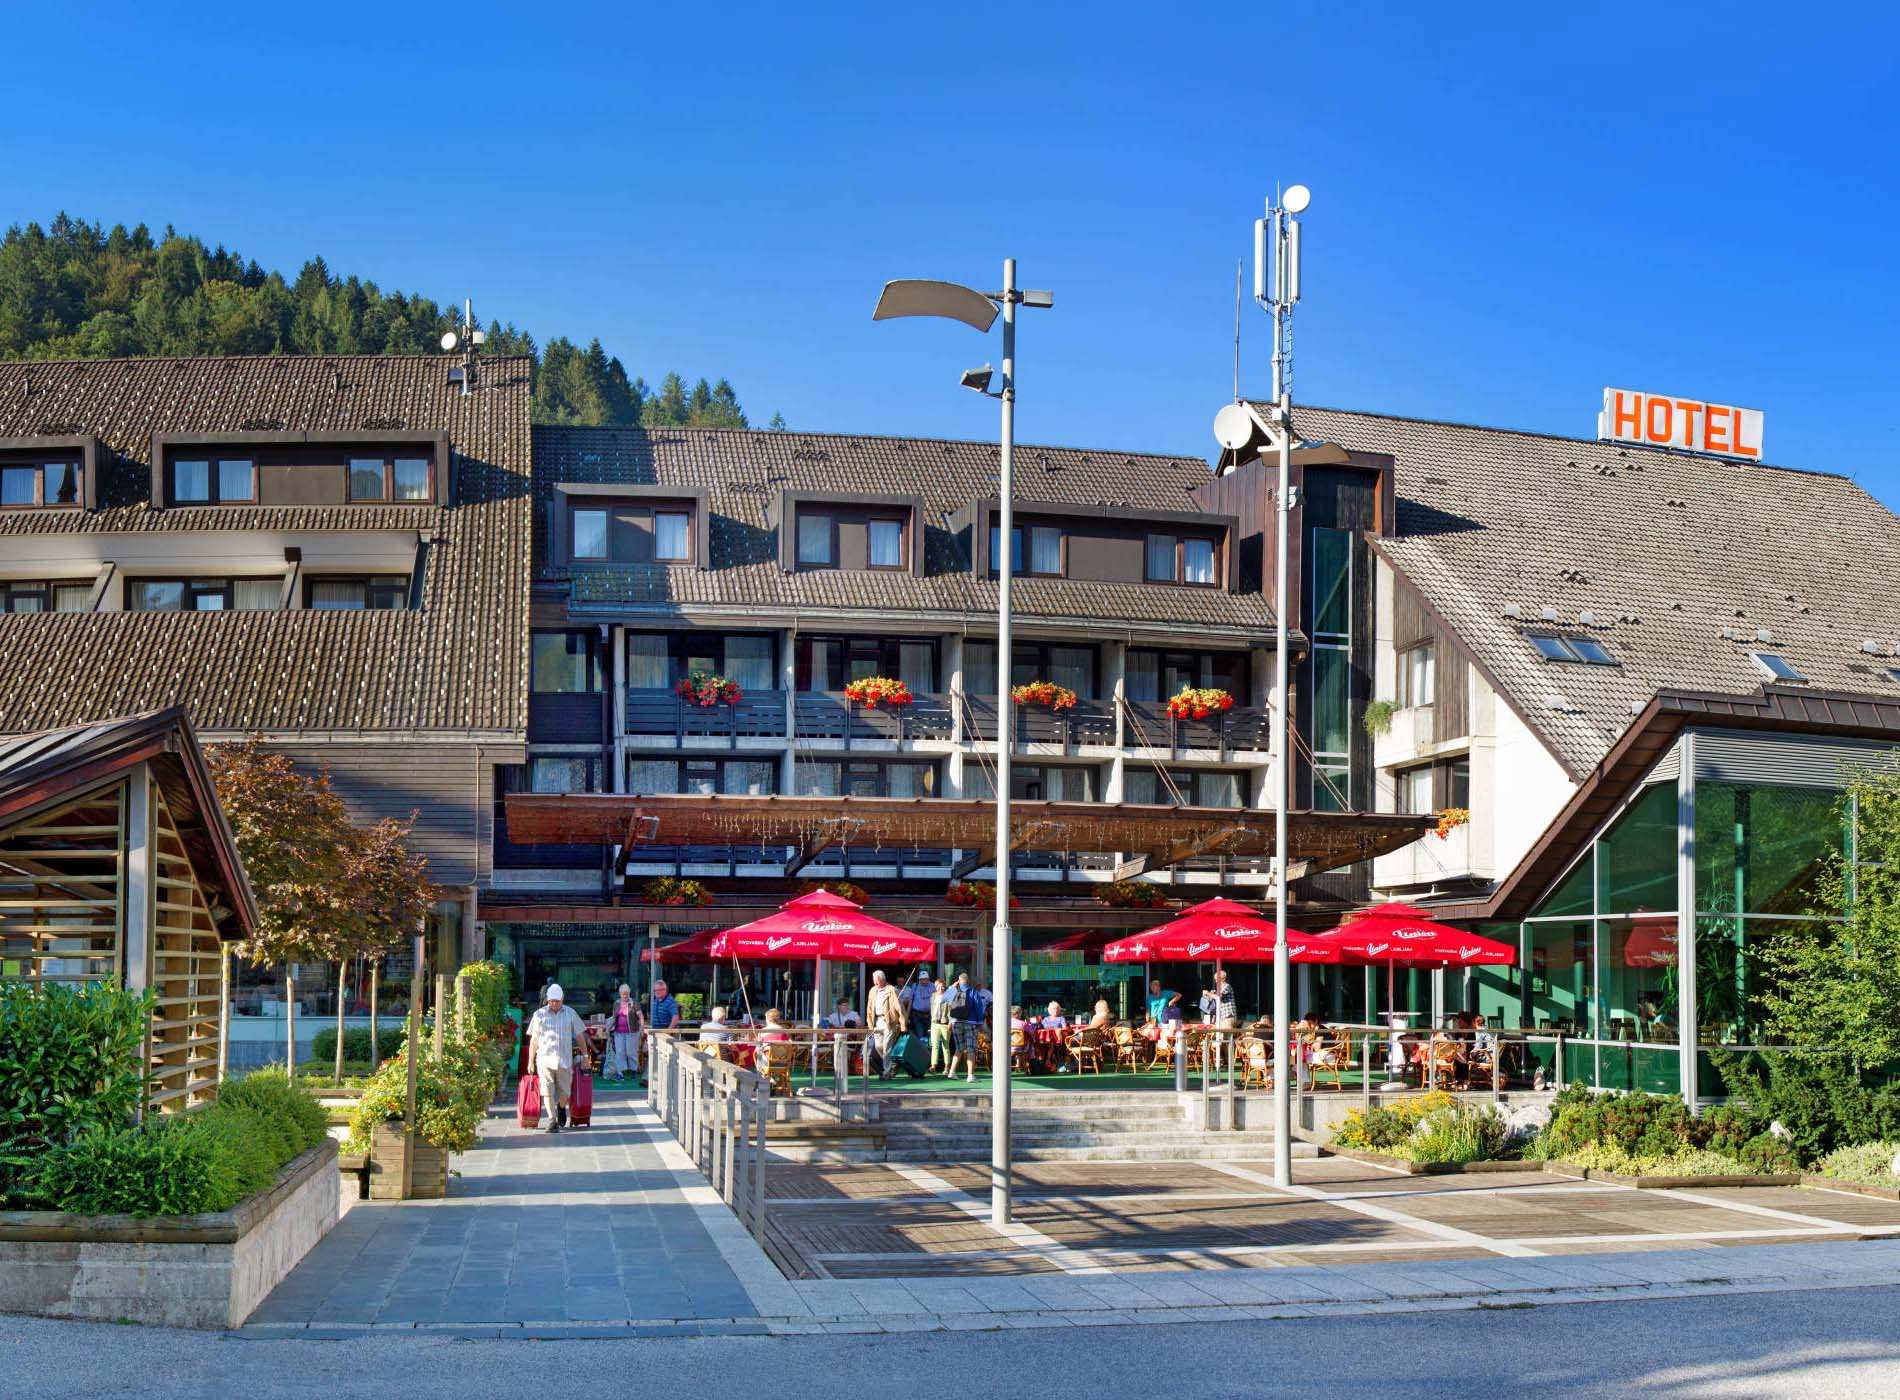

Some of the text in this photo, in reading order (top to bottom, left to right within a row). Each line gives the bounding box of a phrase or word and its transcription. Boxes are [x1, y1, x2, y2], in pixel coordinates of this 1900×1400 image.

[1615, 392, 1757, 456] HOTEL
[802, 922, 854, 933] Union
[1214, 928, 1261, 939] Union
[1392, 929, 1437, 939] Union
[766, 936, 792, 951] Union
[871, 940, 897, 955] Union
[1187, 942, 1210, 957] Union
[1366, 942, 1389, 957] Union
[1459, 945, 1481, 960] Union
